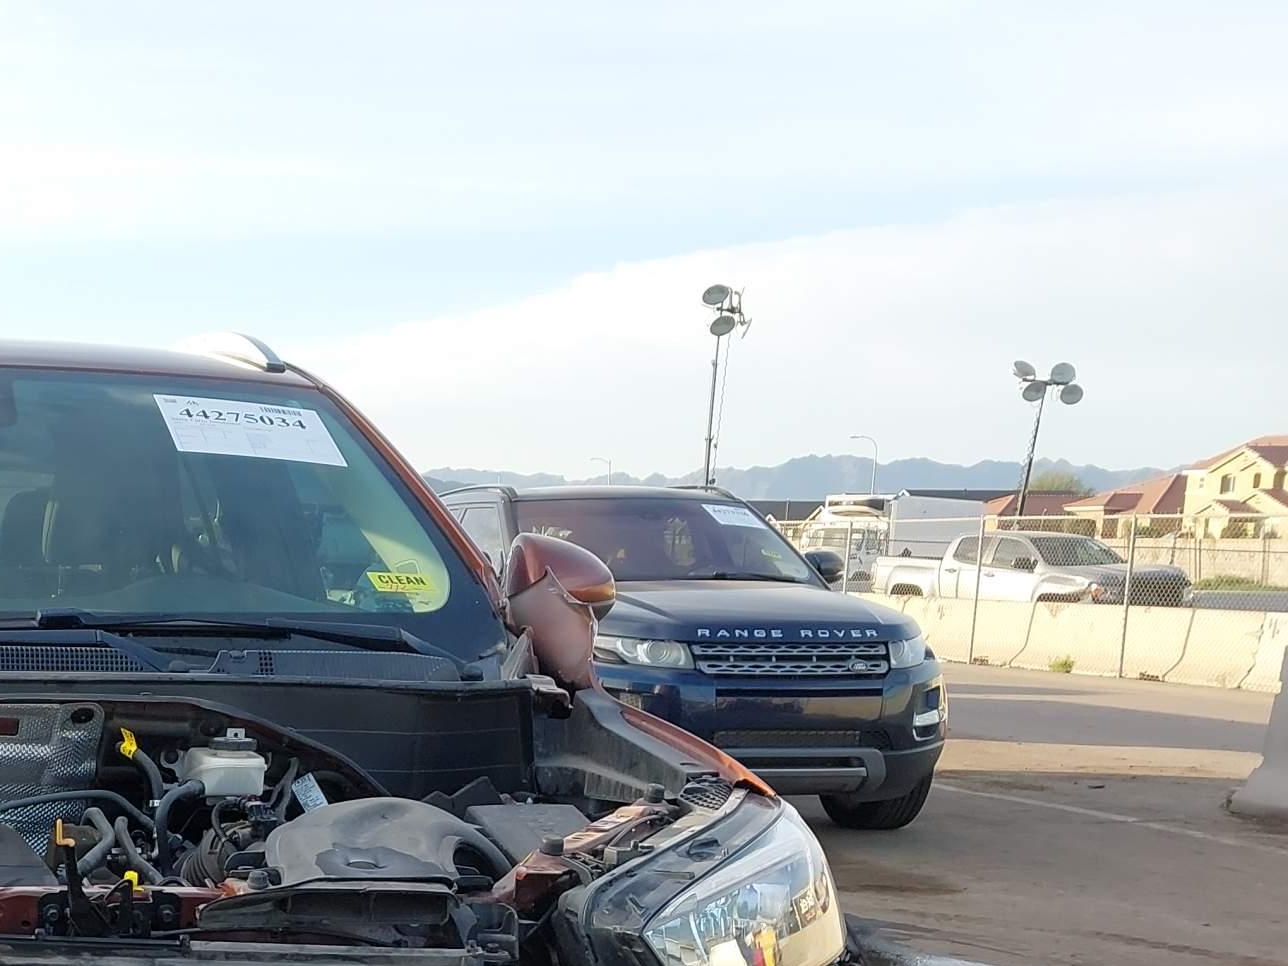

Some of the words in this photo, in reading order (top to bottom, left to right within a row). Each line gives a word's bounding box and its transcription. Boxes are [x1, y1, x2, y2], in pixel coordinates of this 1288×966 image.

[179, 407, 307, 429] 44275034
[377, 574, 427, 586] CLEAN
[697, 628, 783, 638] RANGE
[800, 628, 879, 638] ROVER
